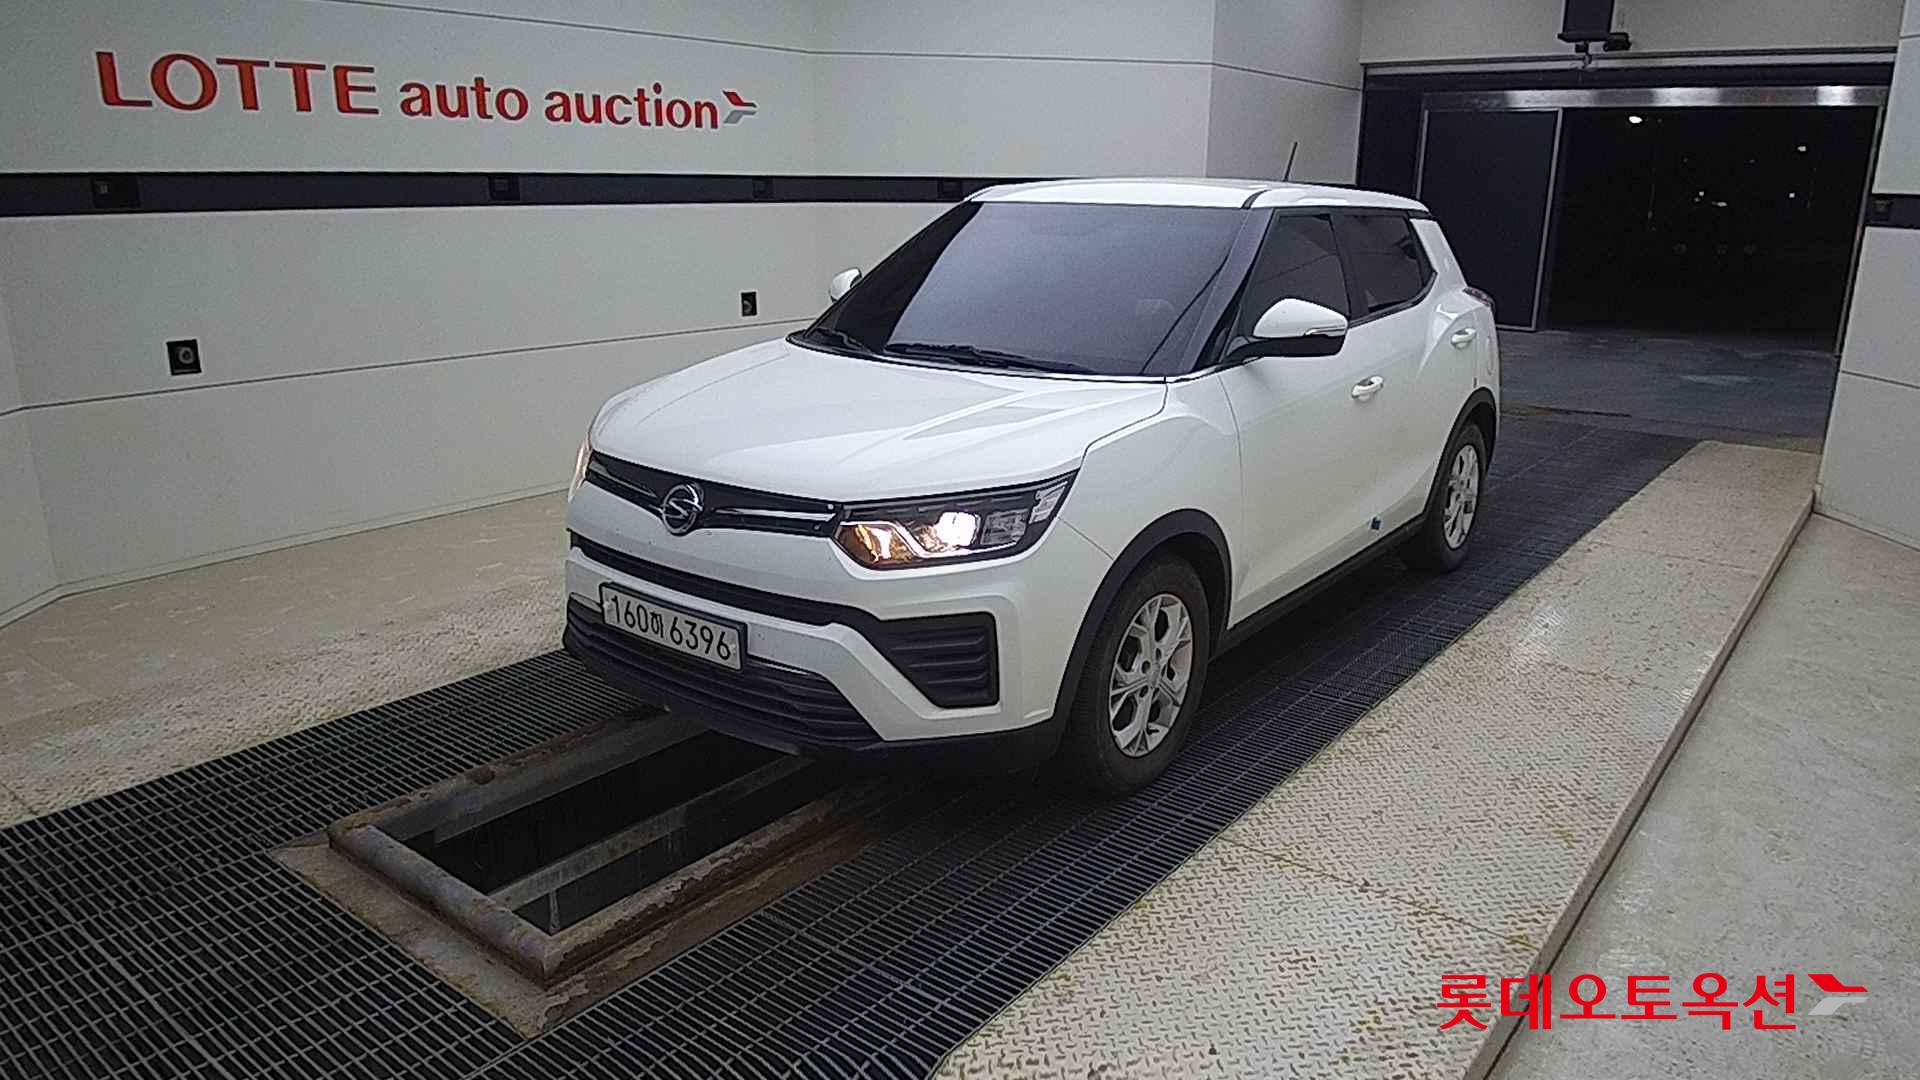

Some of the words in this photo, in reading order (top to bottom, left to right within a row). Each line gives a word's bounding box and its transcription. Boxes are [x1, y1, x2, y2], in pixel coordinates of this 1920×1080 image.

[95, 51, 379, 115] LOTTE
[400, 77, 528, 121] auto
[544, 83, 718, 129] auction
